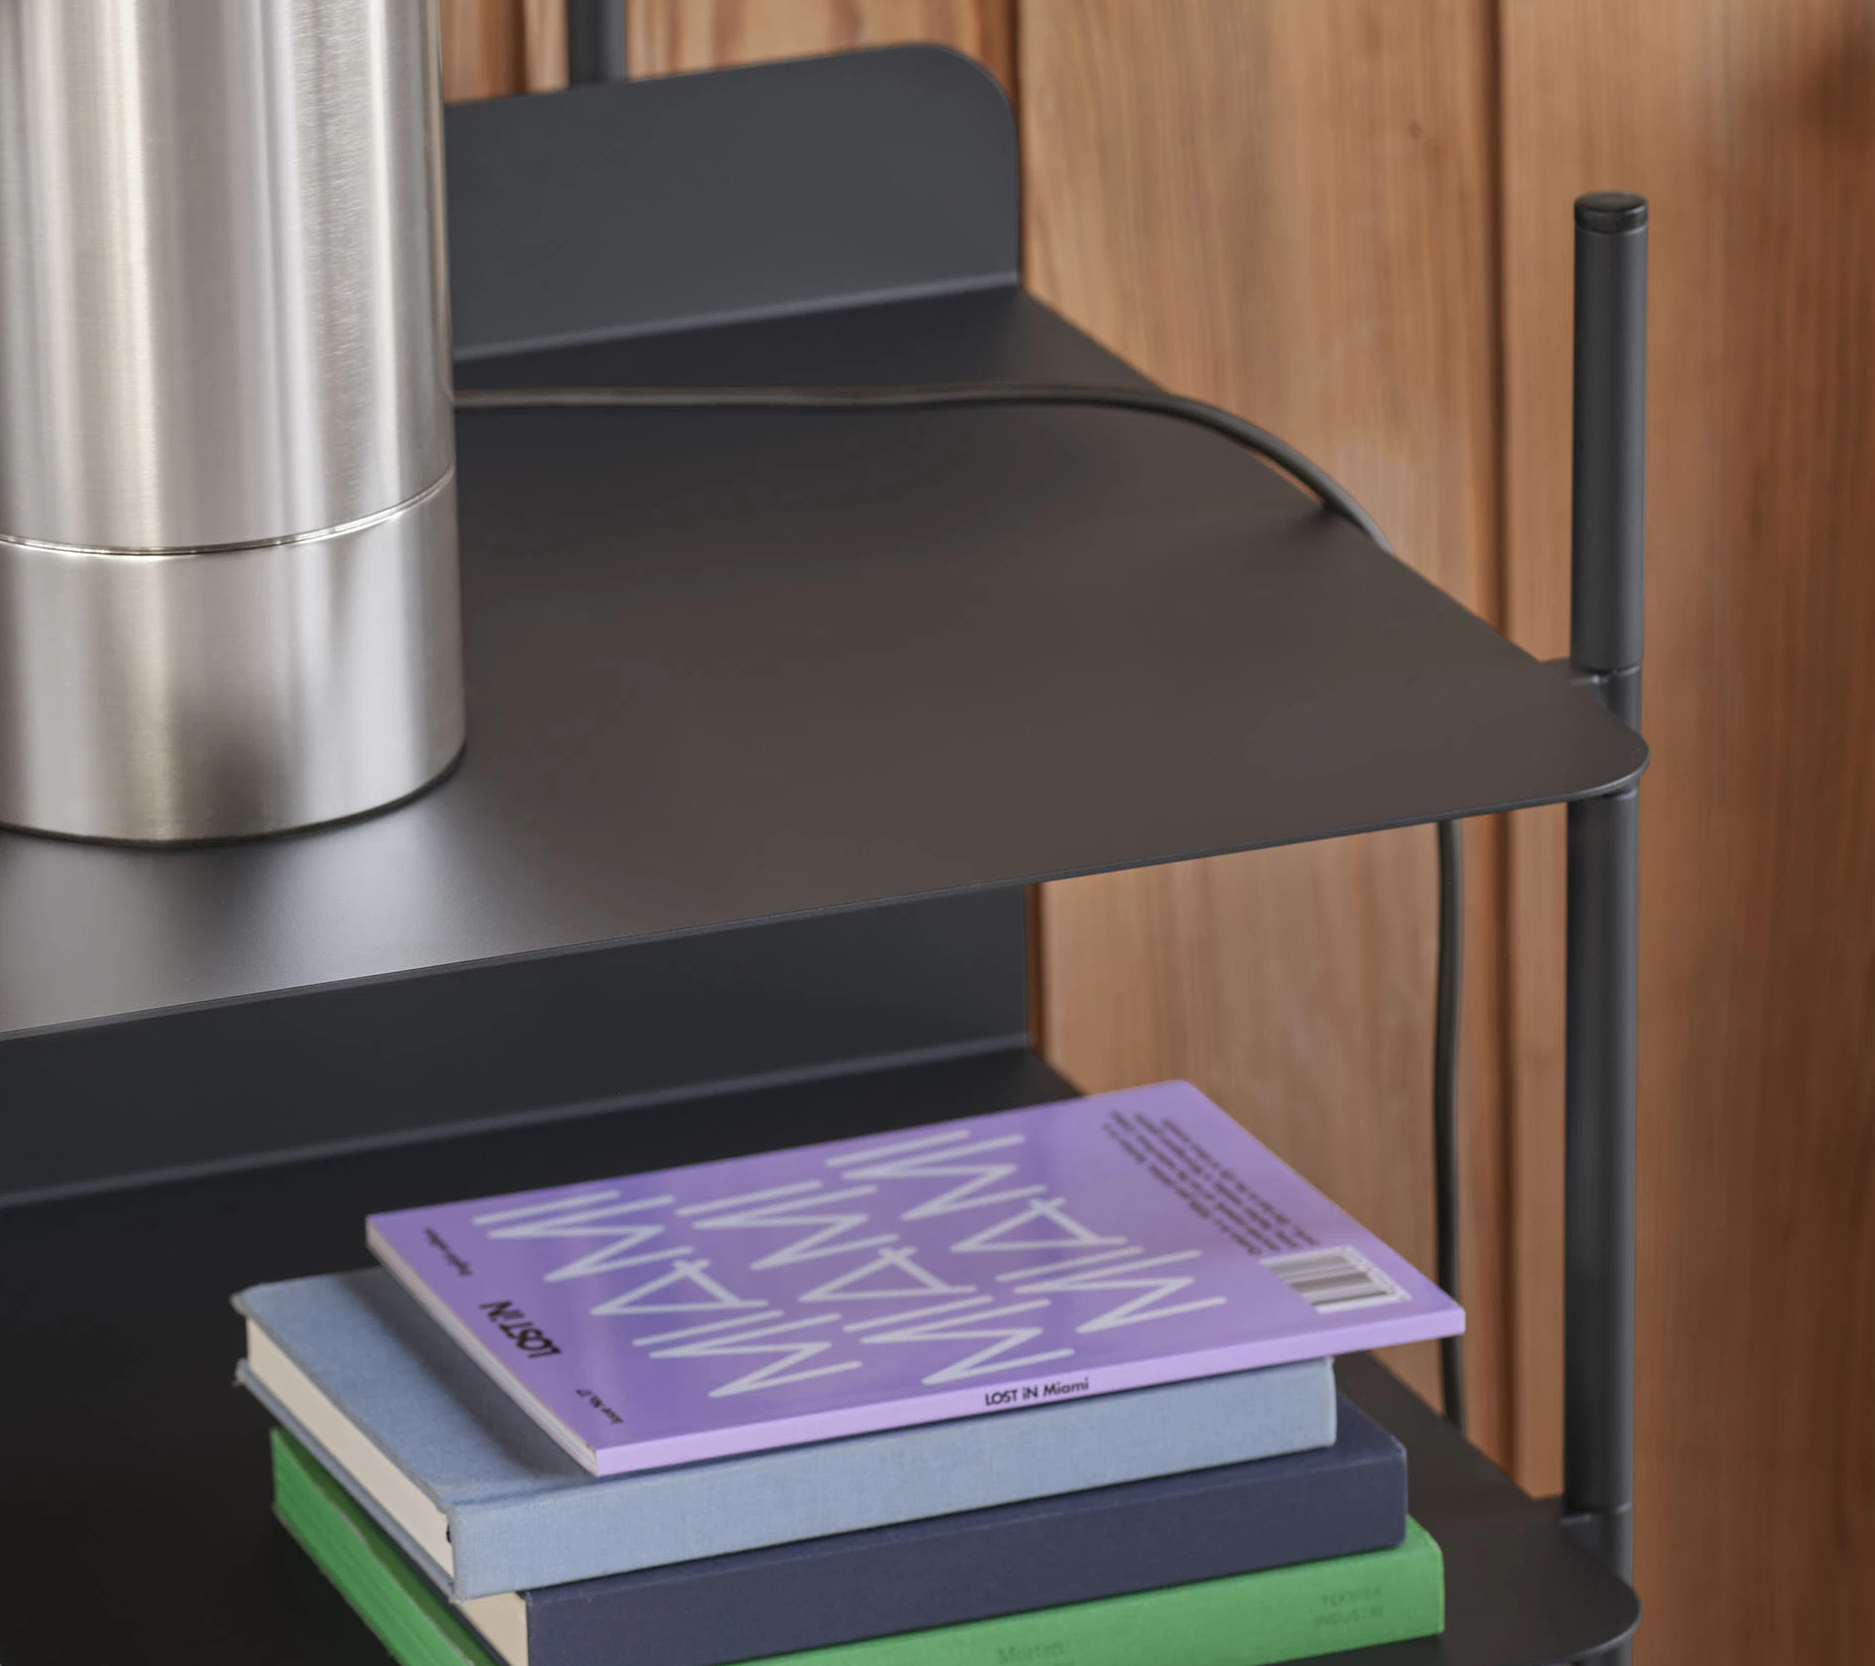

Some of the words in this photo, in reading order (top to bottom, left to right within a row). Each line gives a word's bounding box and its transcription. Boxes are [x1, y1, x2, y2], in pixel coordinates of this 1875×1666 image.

[498, 1321, 562, 1359] LOST
[985, 1388, 1018, 1406] LOST
[1043, 1376, 1090, 1397] Miami
